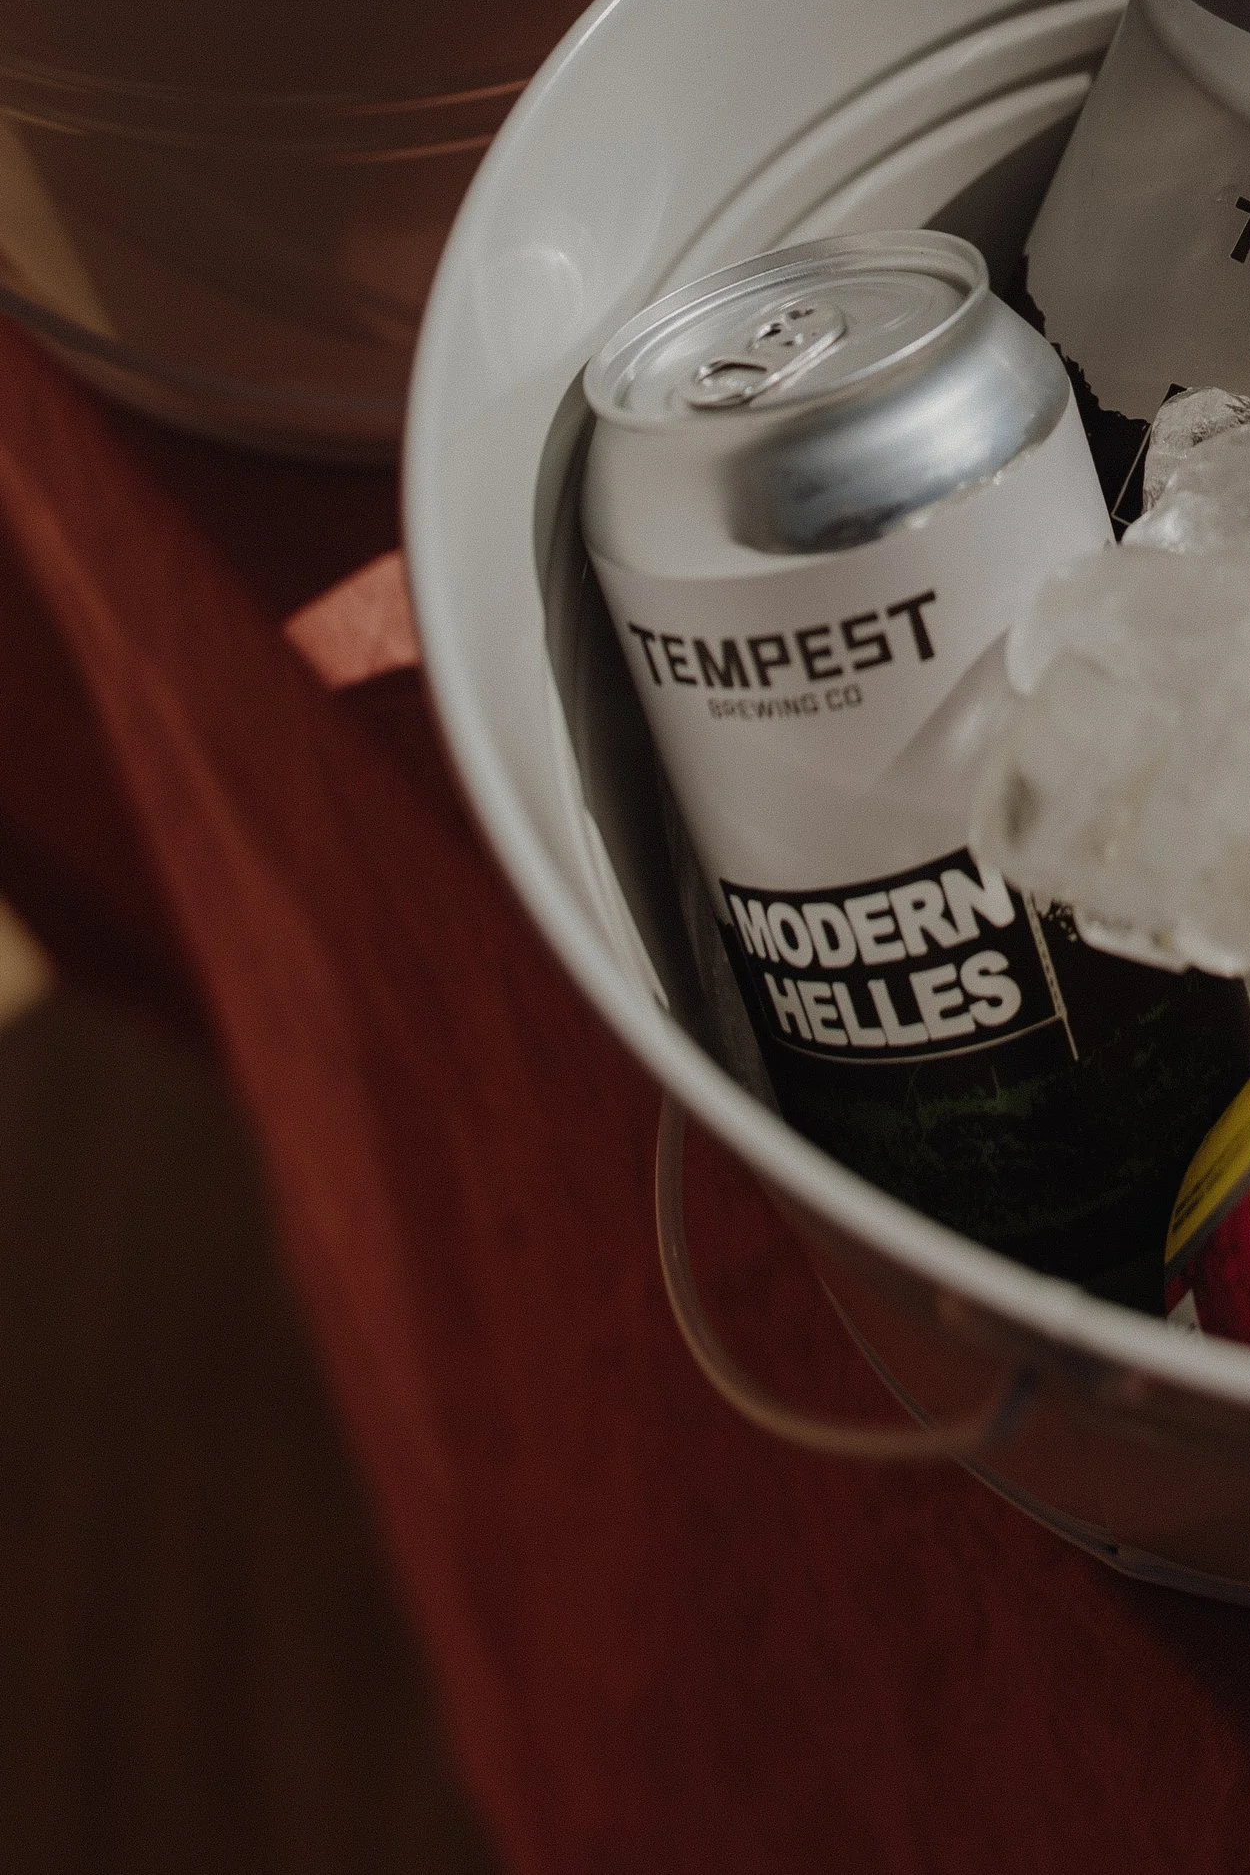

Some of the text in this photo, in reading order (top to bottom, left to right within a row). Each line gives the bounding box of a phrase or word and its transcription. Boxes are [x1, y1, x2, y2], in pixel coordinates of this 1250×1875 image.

[626, 589, 938, 688] TEMPEST
[708, 683, 863, 721] BREWING CO
[730, 868, 1016, 969] MODERN
[764, 950, 1023, 1048] HELLES
